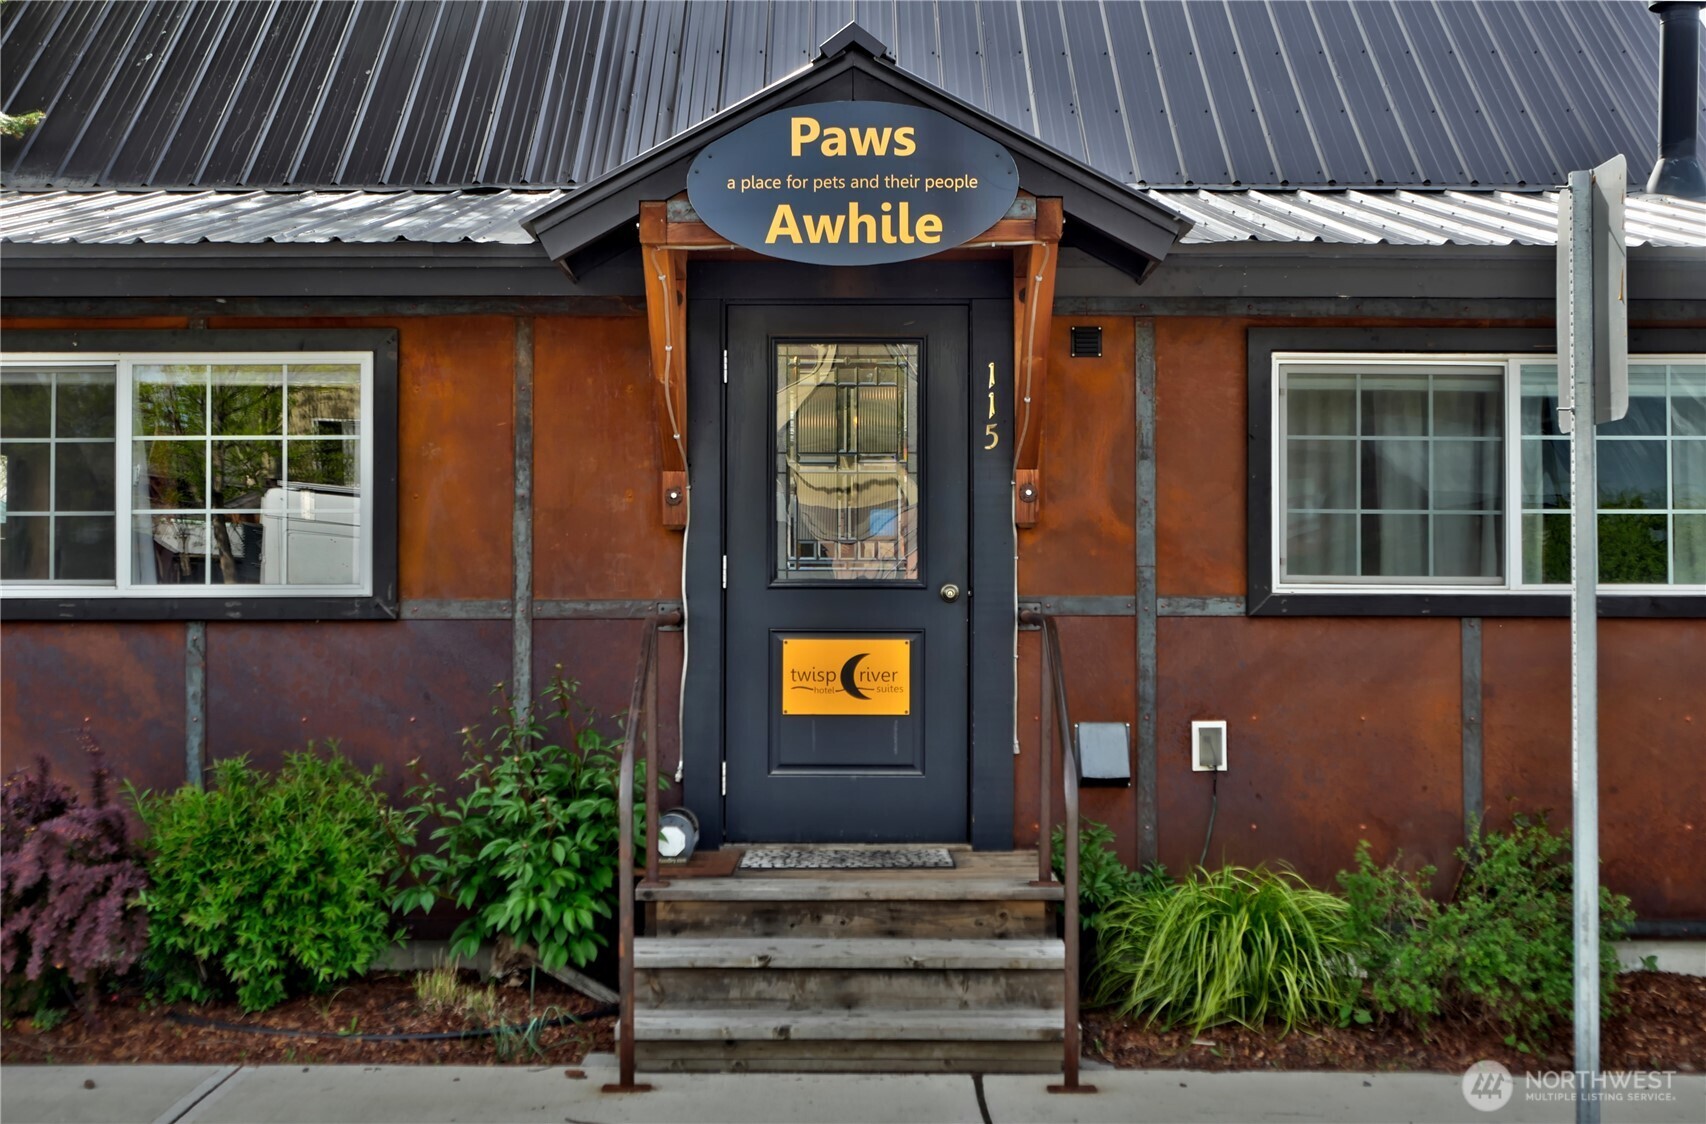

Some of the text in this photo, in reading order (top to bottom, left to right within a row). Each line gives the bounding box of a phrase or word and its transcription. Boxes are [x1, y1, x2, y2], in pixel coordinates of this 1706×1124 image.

[790, 117, 917, 157] Paws
[727, 173, 979, 193] a place for pets and their people
[764, 201, 944, 245] Awhile
[984, 362, 999, 450] 115
[790, 667, 899, 686] twisp river
[813, 684, 904, 695] hotel suites
